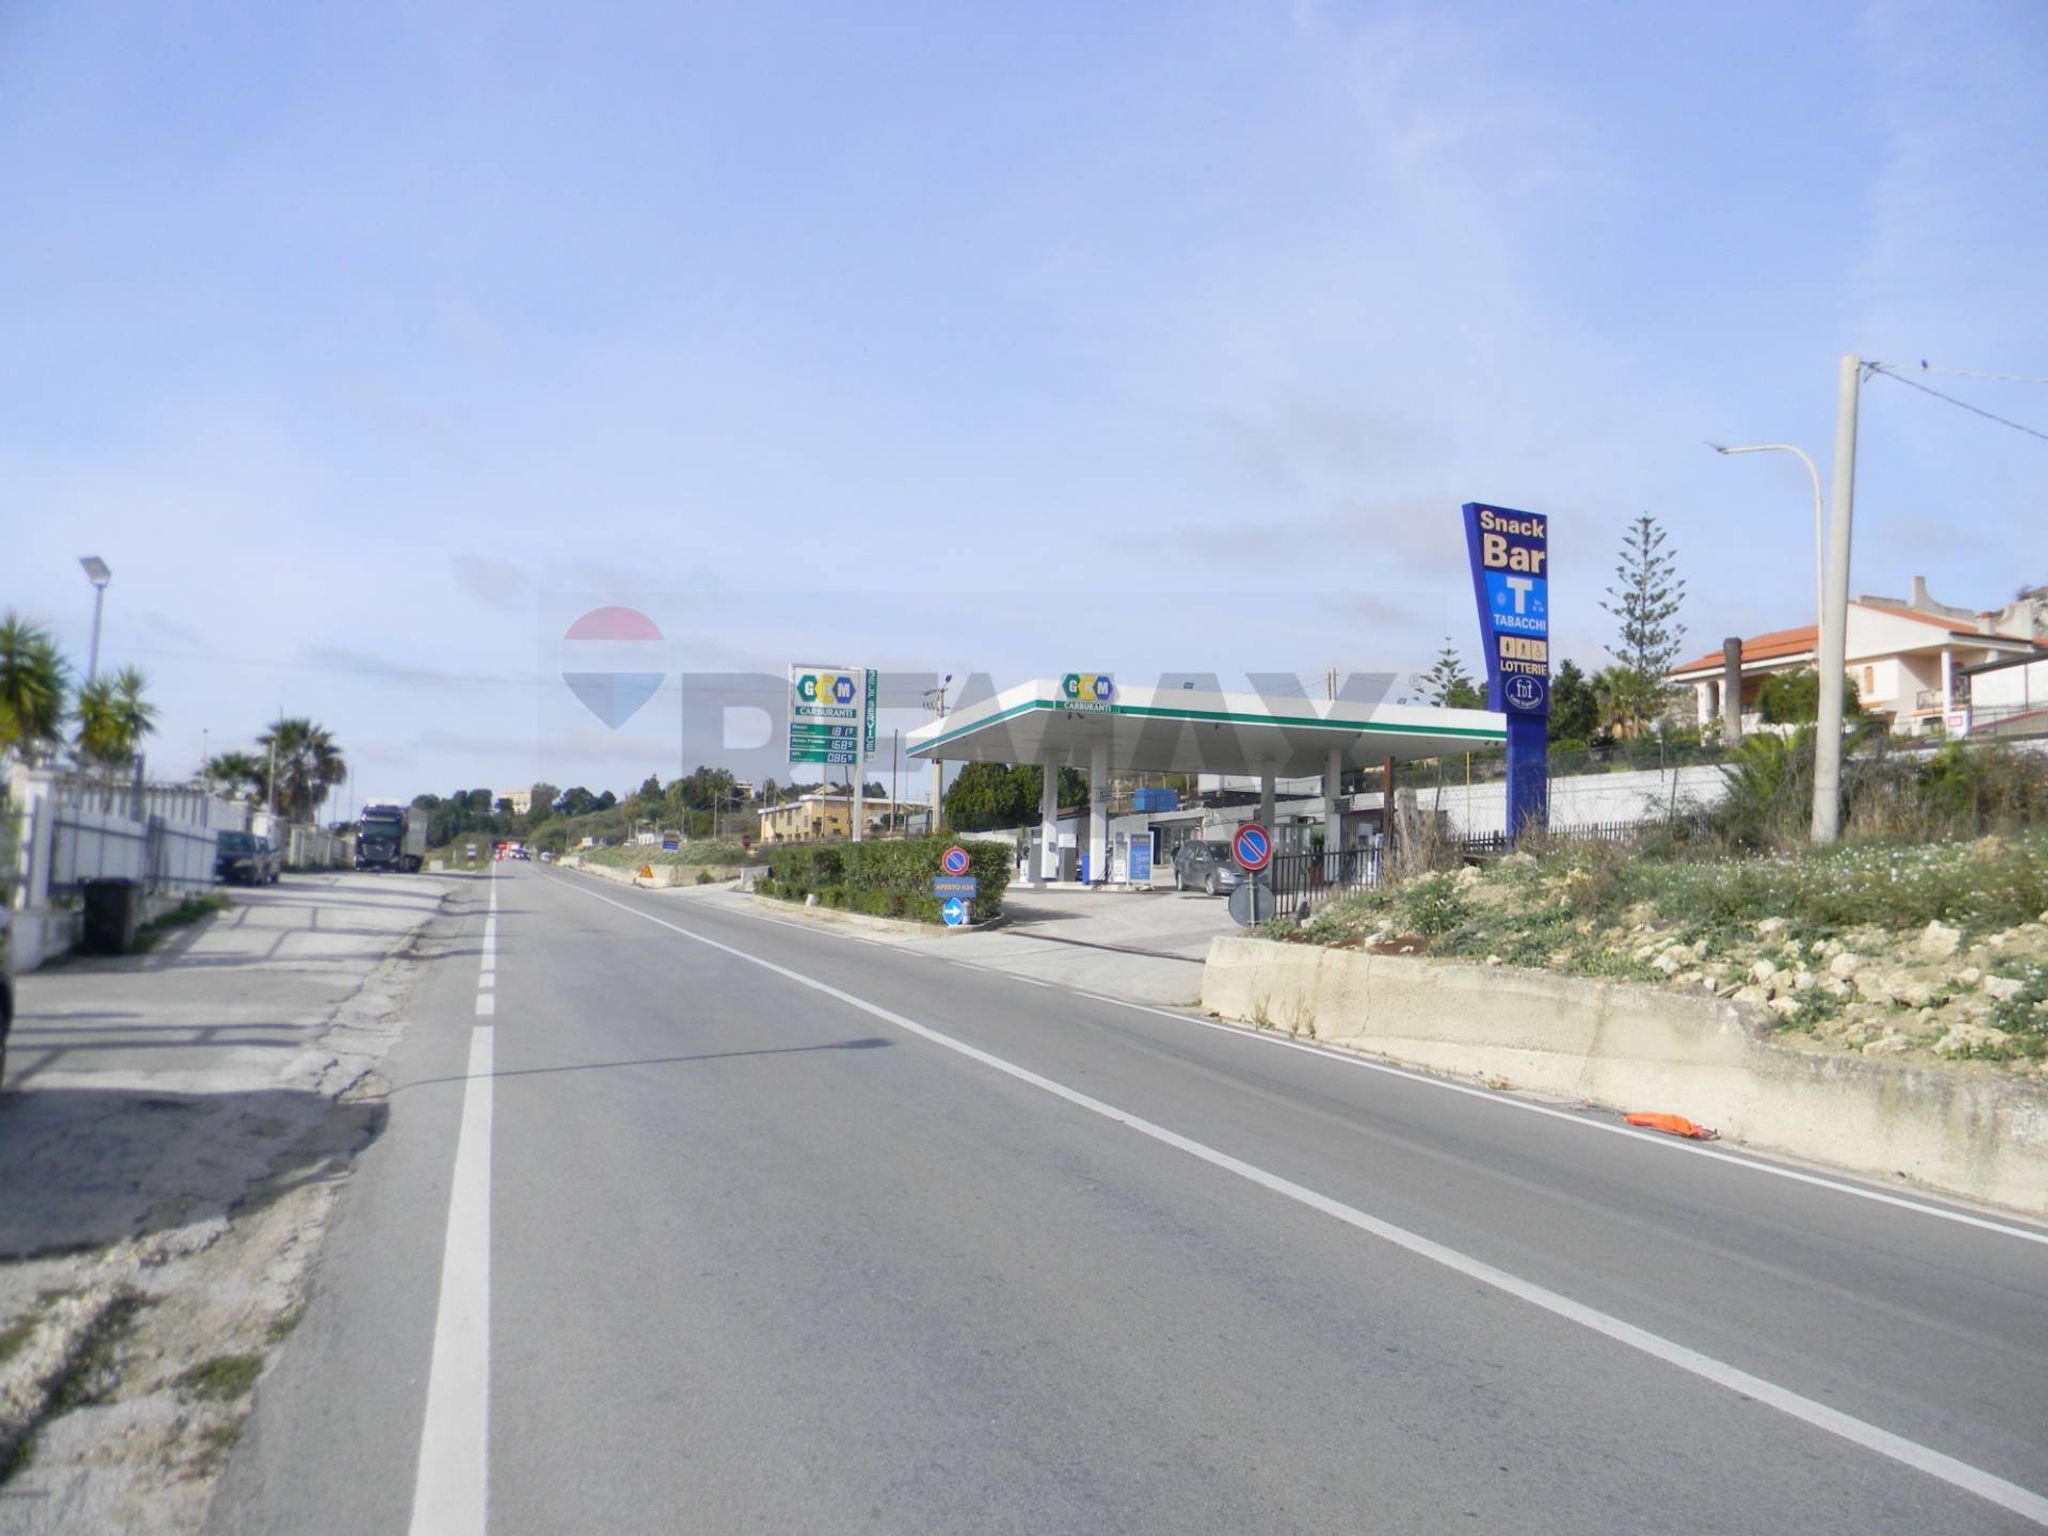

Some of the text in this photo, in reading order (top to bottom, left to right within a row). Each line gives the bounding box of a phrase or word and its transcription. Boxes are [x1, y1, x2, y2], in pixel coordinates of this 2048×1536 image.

[1480, 510, 1545, 539] Snack
[1483, 532, 1546, 574] Bar
[1506, 576, 1534, 615] T
[1493, 613, 1547, 632] TABACCHI
[1500, 660, 1548, 676] LOTTERIE
[800, 707, 853, 717] CARBURANTI
[1064, 701, 1111, 712] CARBURANTI
